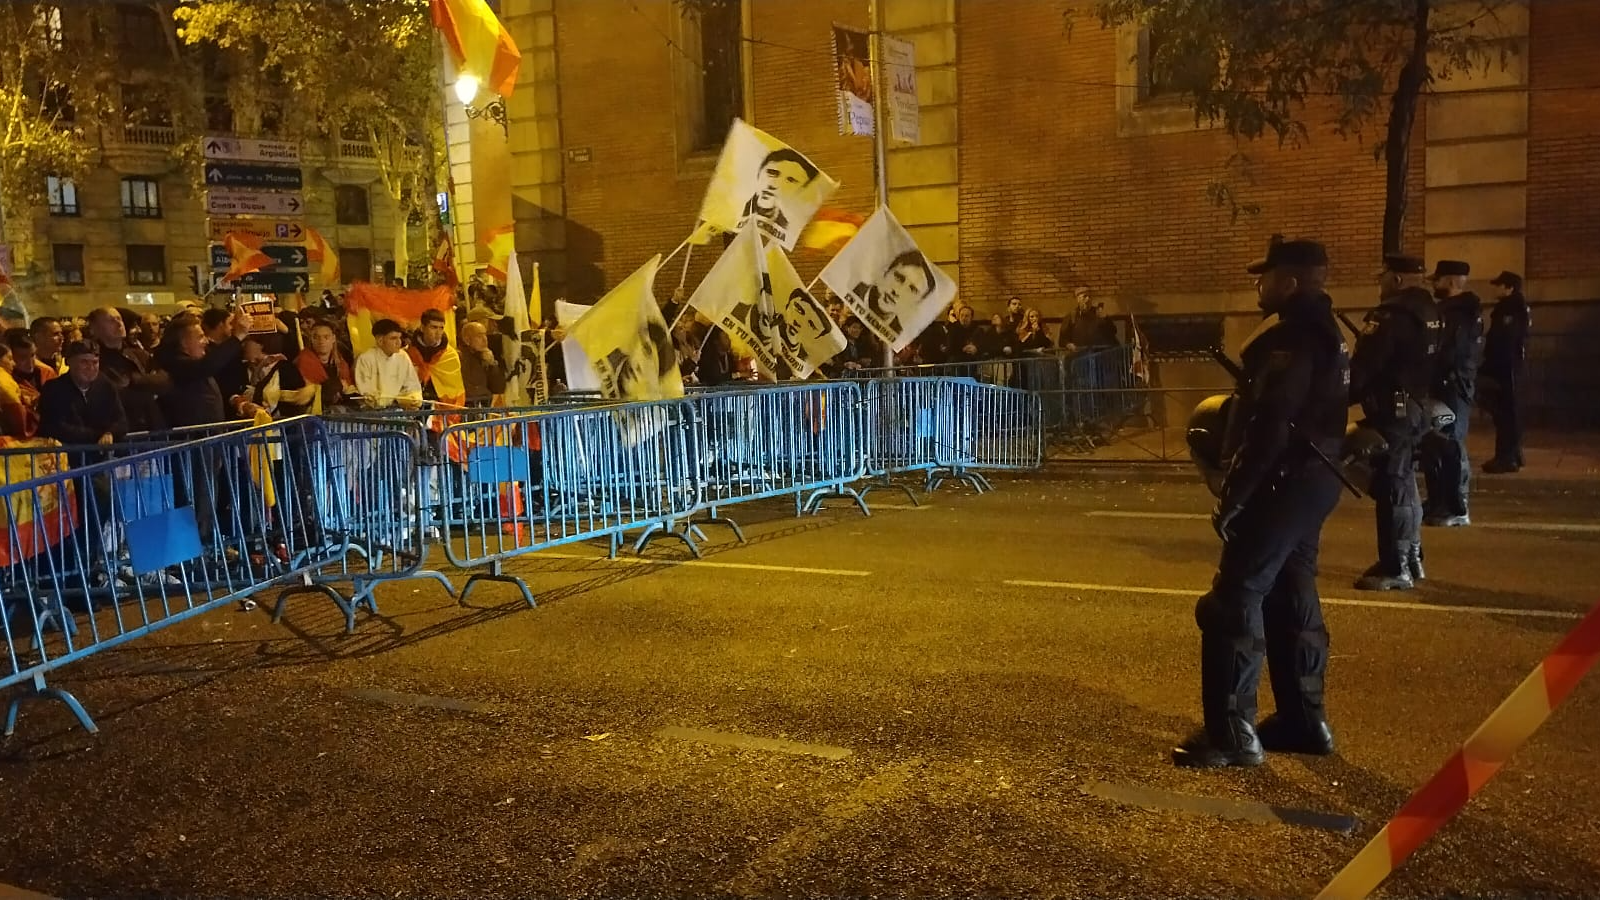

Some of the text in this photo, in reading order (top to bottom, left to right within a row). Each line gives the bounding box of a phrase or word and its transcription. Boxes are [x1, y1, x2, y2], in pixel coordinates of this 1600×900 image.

[277, 225, 287, 237] P
[721, 316, 736, 330] EN
[735, 326, 749, 341] TU
